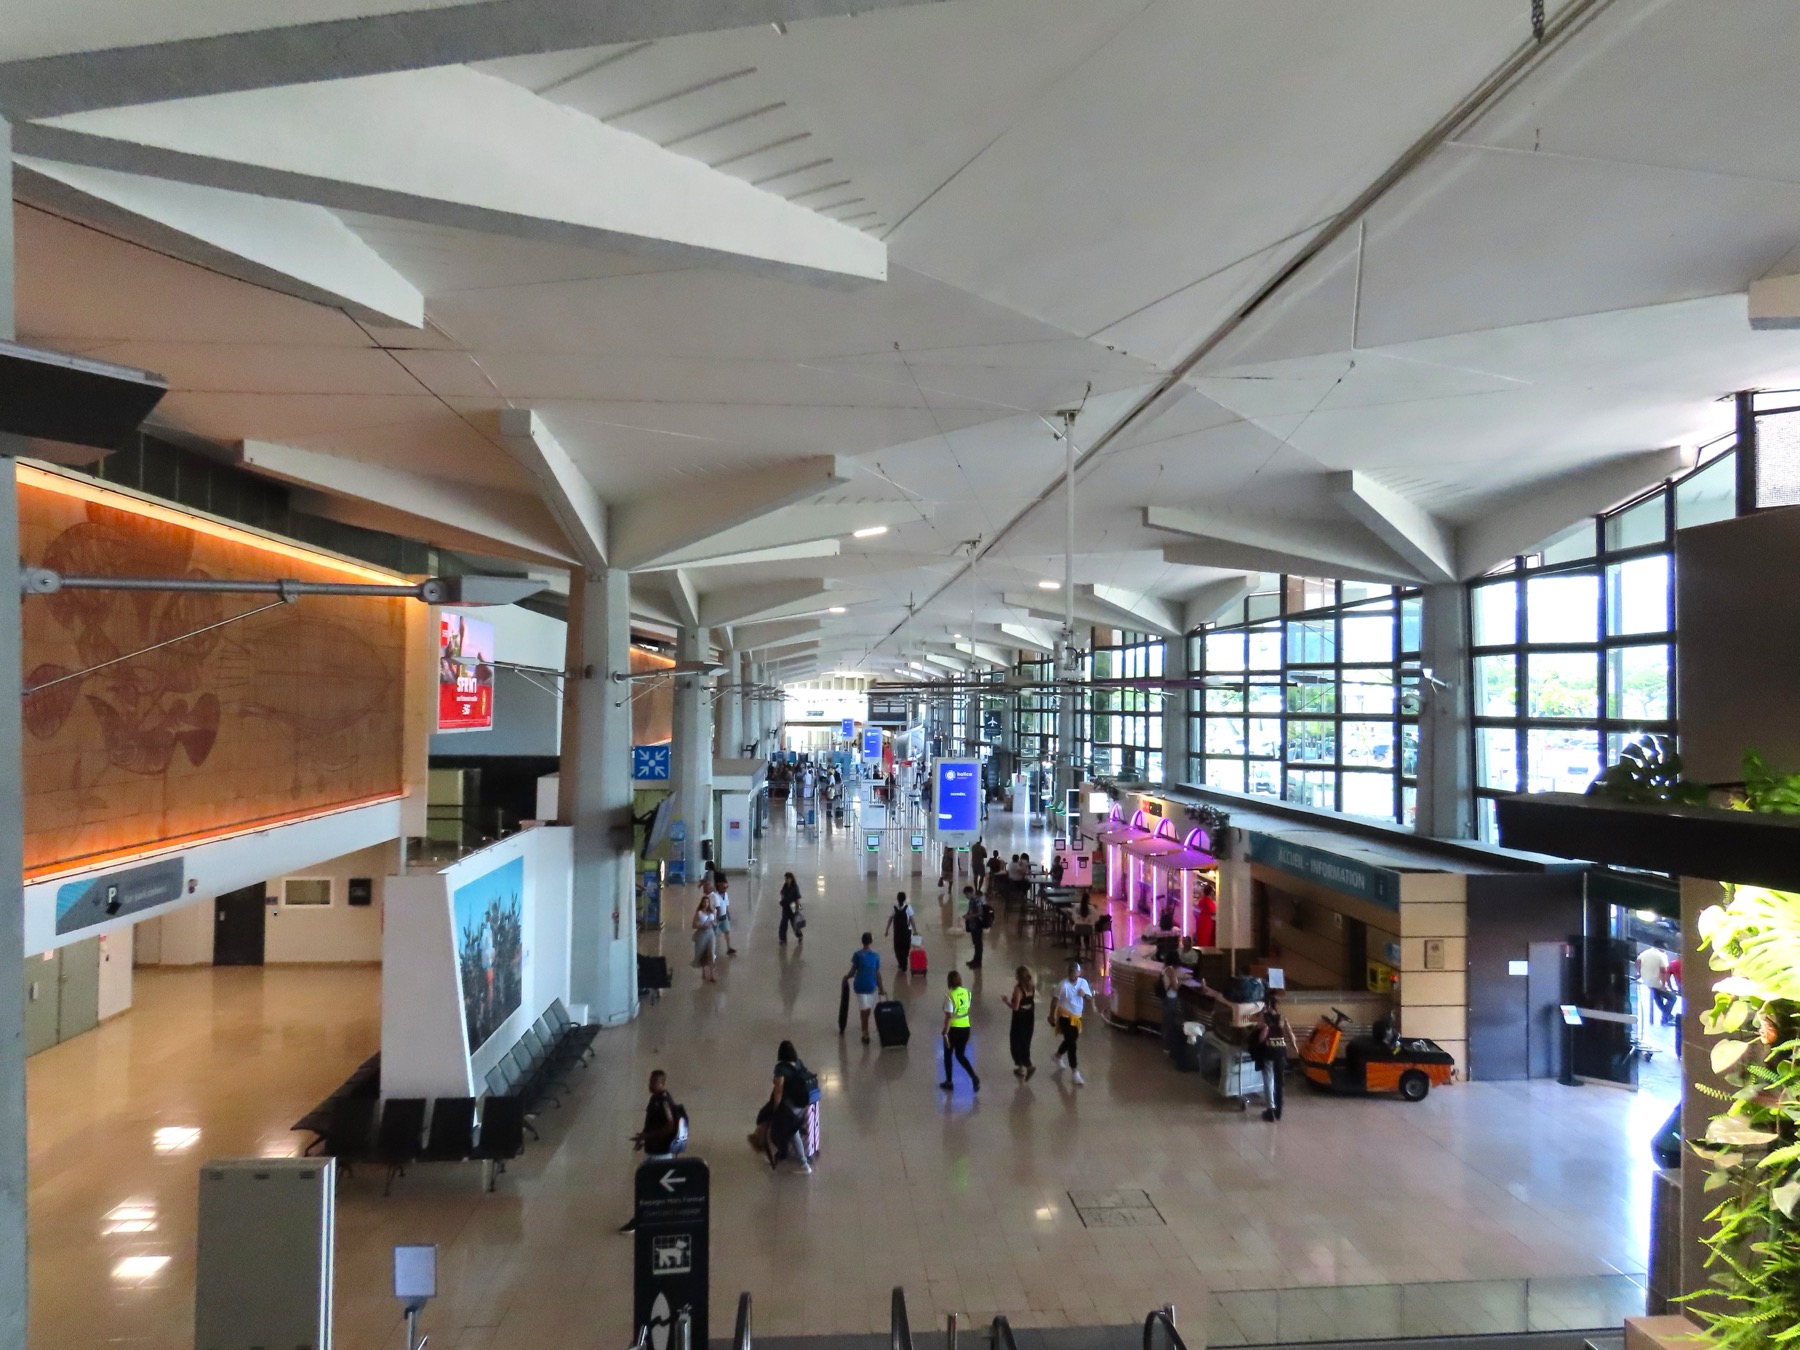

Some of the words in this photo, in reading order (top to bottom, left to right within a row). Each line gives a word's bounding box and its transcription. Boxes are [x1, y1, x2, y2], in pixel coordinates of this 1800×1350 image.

[456, 676, 469, 693] SFR
[1278, 847, 1304, 870] ACCUEIL
[1310, 859, 1365, 890] INFORMATION
[108, 887, 117, 903] P
